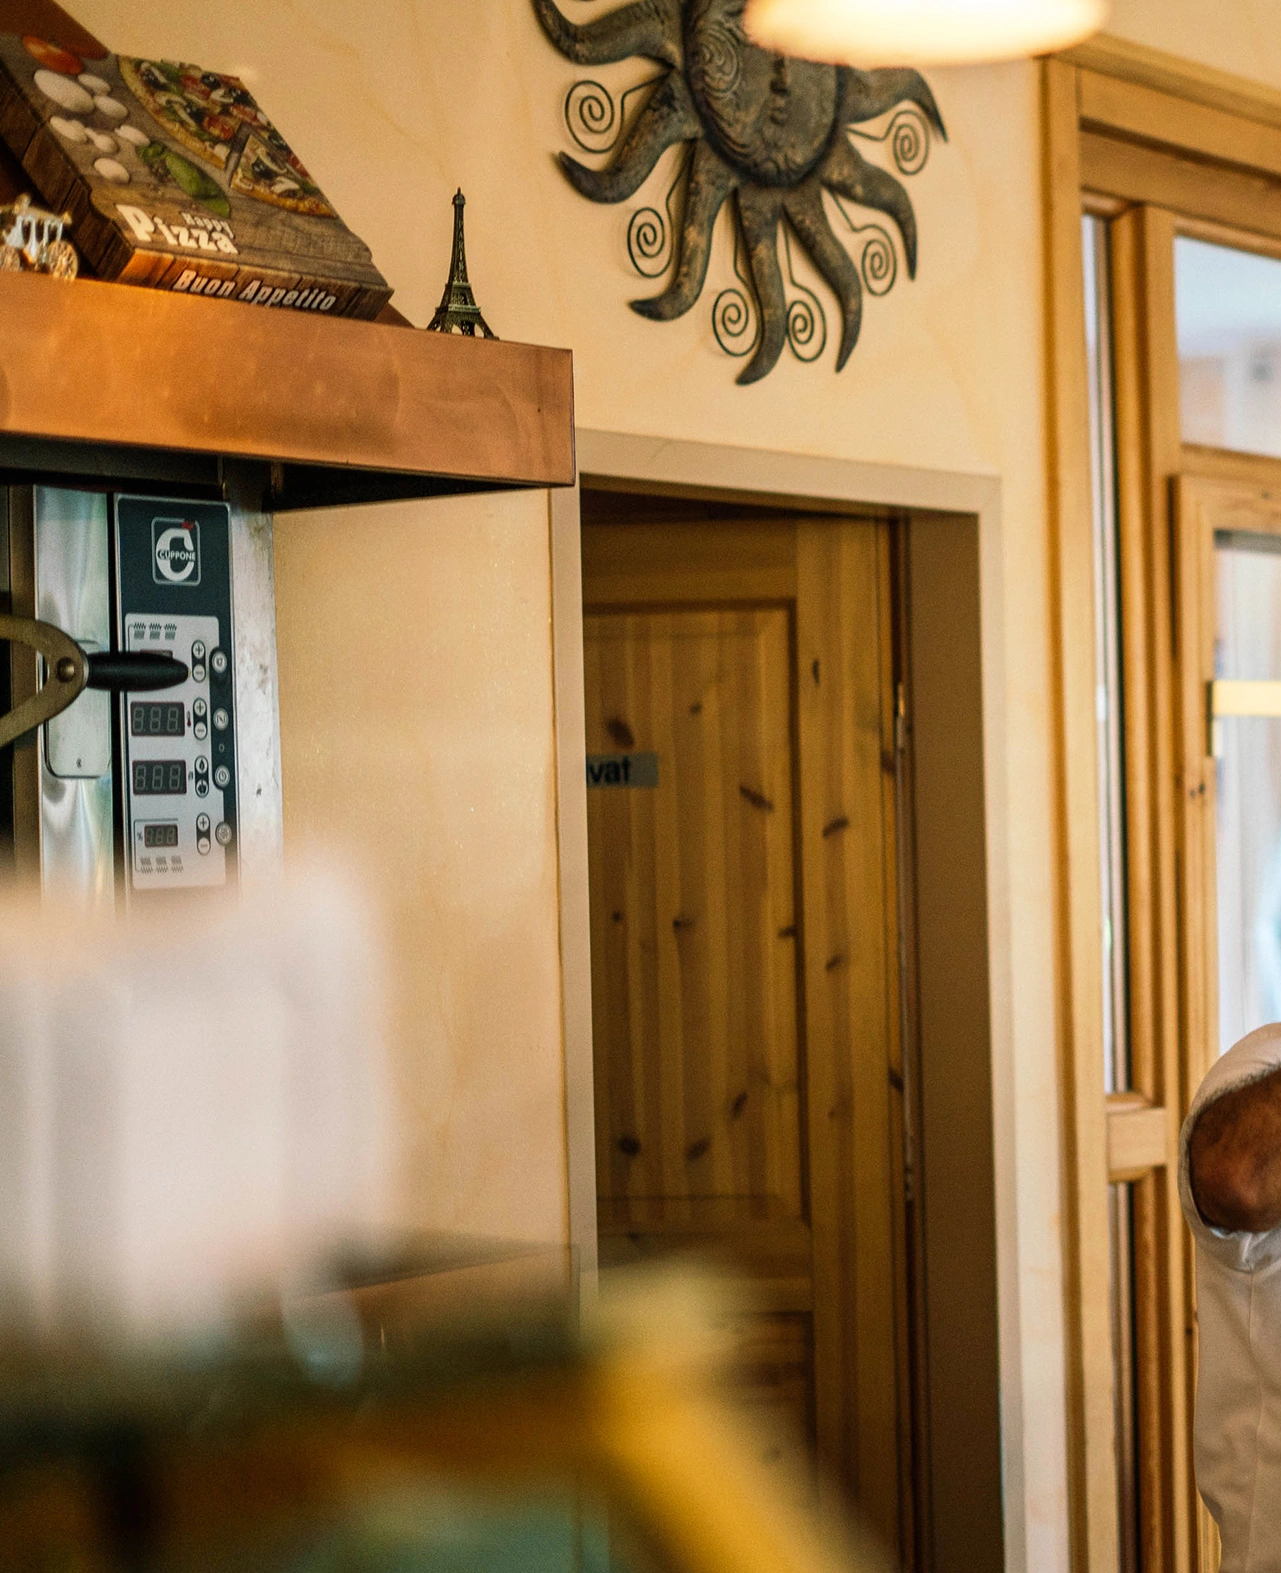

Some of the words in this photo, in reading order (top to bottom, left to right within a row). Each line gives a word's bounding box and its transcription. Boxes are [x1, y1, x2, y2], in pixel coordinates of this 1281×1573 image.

[115, 204, 239, 254] Pizza
[181, 211, 236, 239] Happy
[171, 269, 236, 298] Buon
[238, 279, 337, 311] Appetito
[159, 549, 196, 562] CUPPONE
